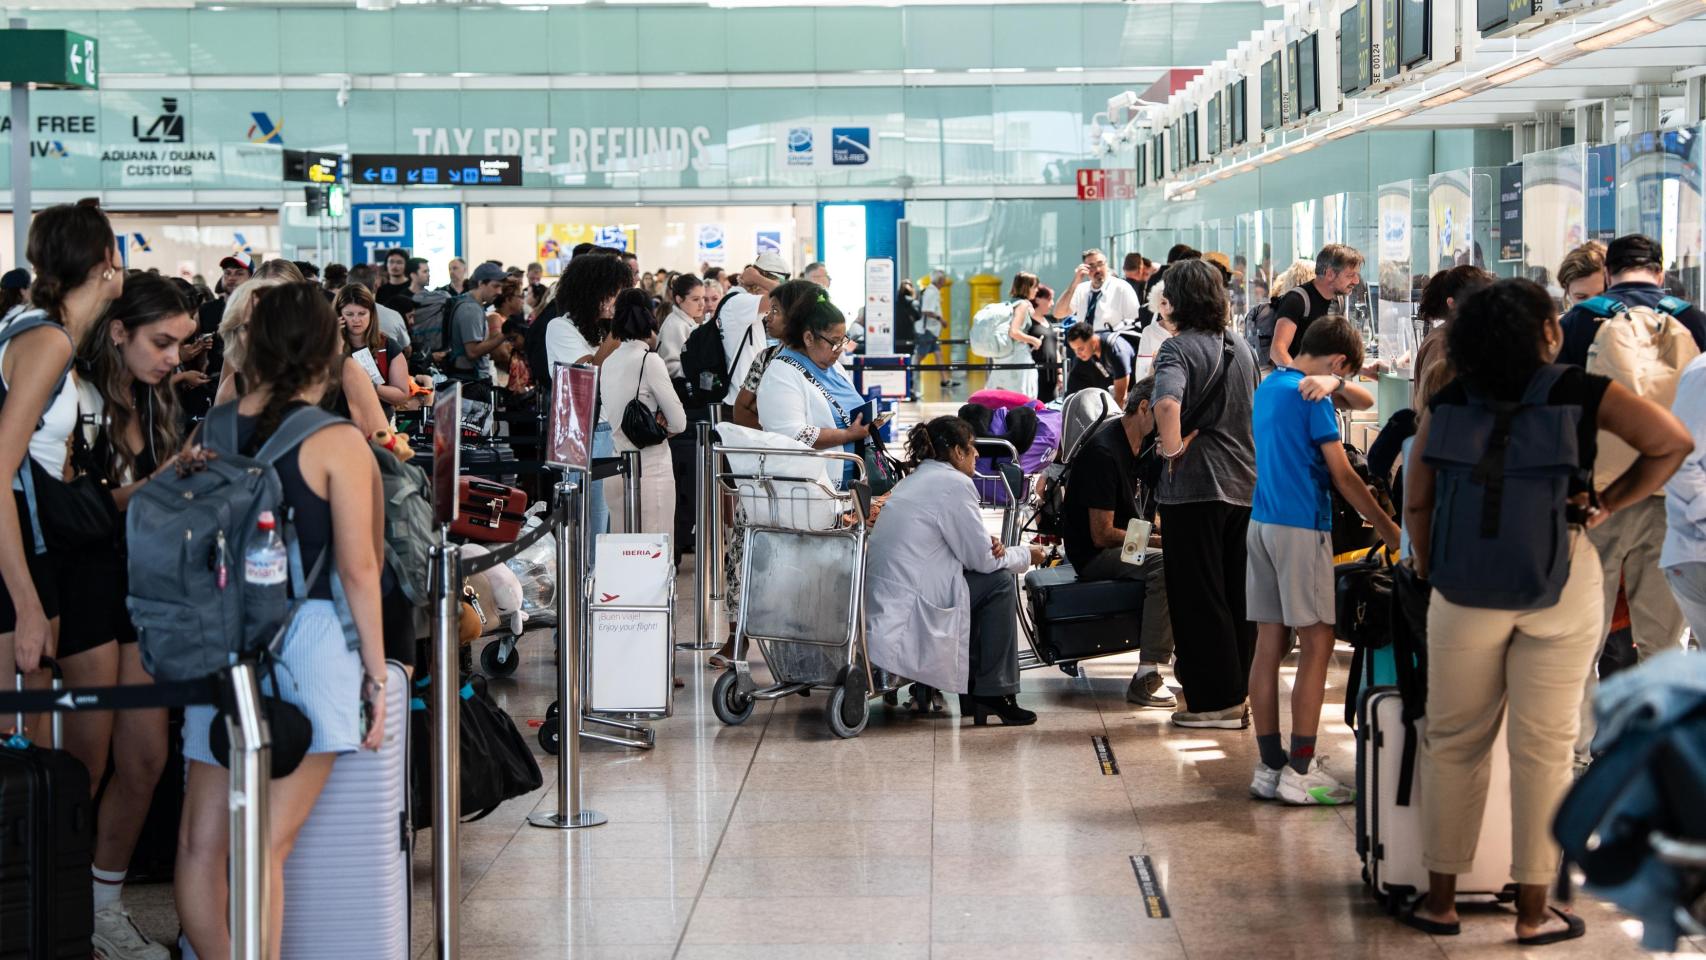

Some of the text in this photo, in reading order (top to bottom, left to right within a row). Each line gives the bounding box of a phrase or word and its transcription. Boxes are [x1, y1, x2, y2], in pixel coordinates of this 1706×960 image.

[1373, 43, 1381, 84] SE 00124
[37, 116, 96, 133] FREE
[101, 150, 158, 162] ADUANA
[169, 151, 216, 162] DUANA
[412, 125, 711, 174] TAX FREE REFUNDS
[126, 164, 193, 176] CUSTOMS
[599, 623, 658, 632] Enjoy your flight!
